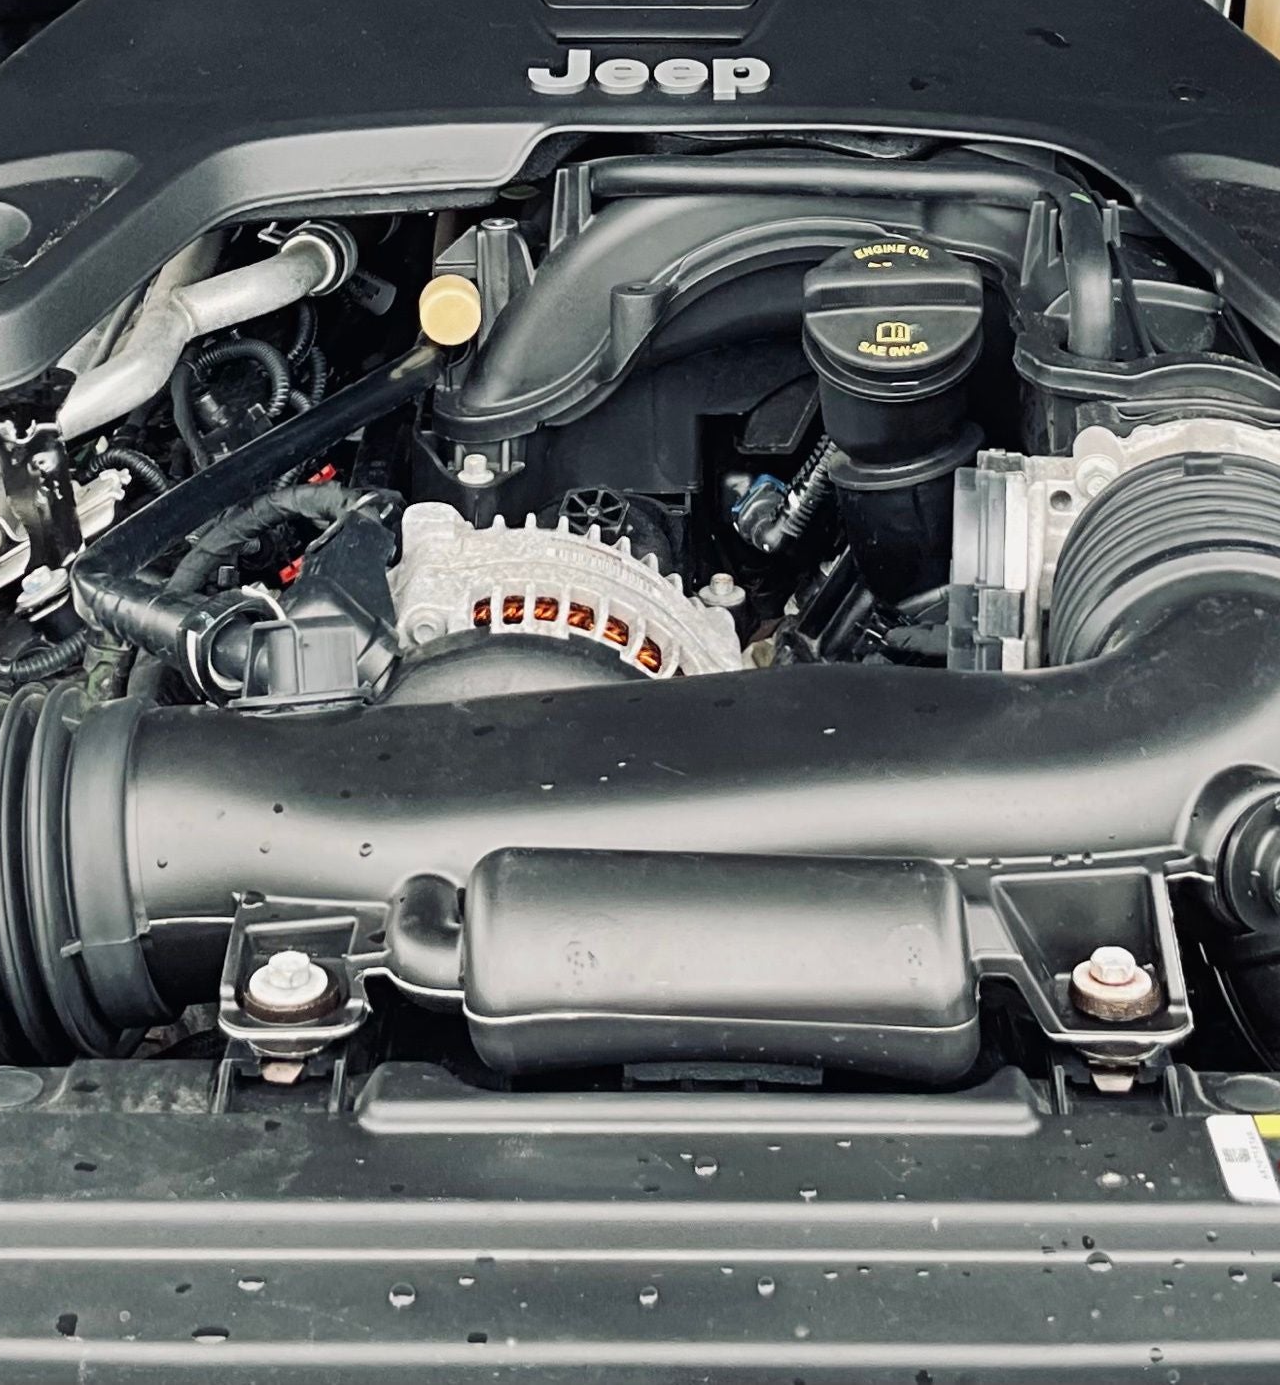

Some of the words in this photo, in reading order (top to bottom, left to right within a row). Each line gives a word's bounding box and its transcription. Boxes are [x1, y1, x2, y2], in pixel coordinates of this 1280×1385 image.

[528, 49, 771, 101] Jeep
[854, 244, 907, 260] ENGINE
[908, 245, 930, 260] OIL
[858, 341, 887, 356] SAE
[888, 341, 929, 357] 0W-20
